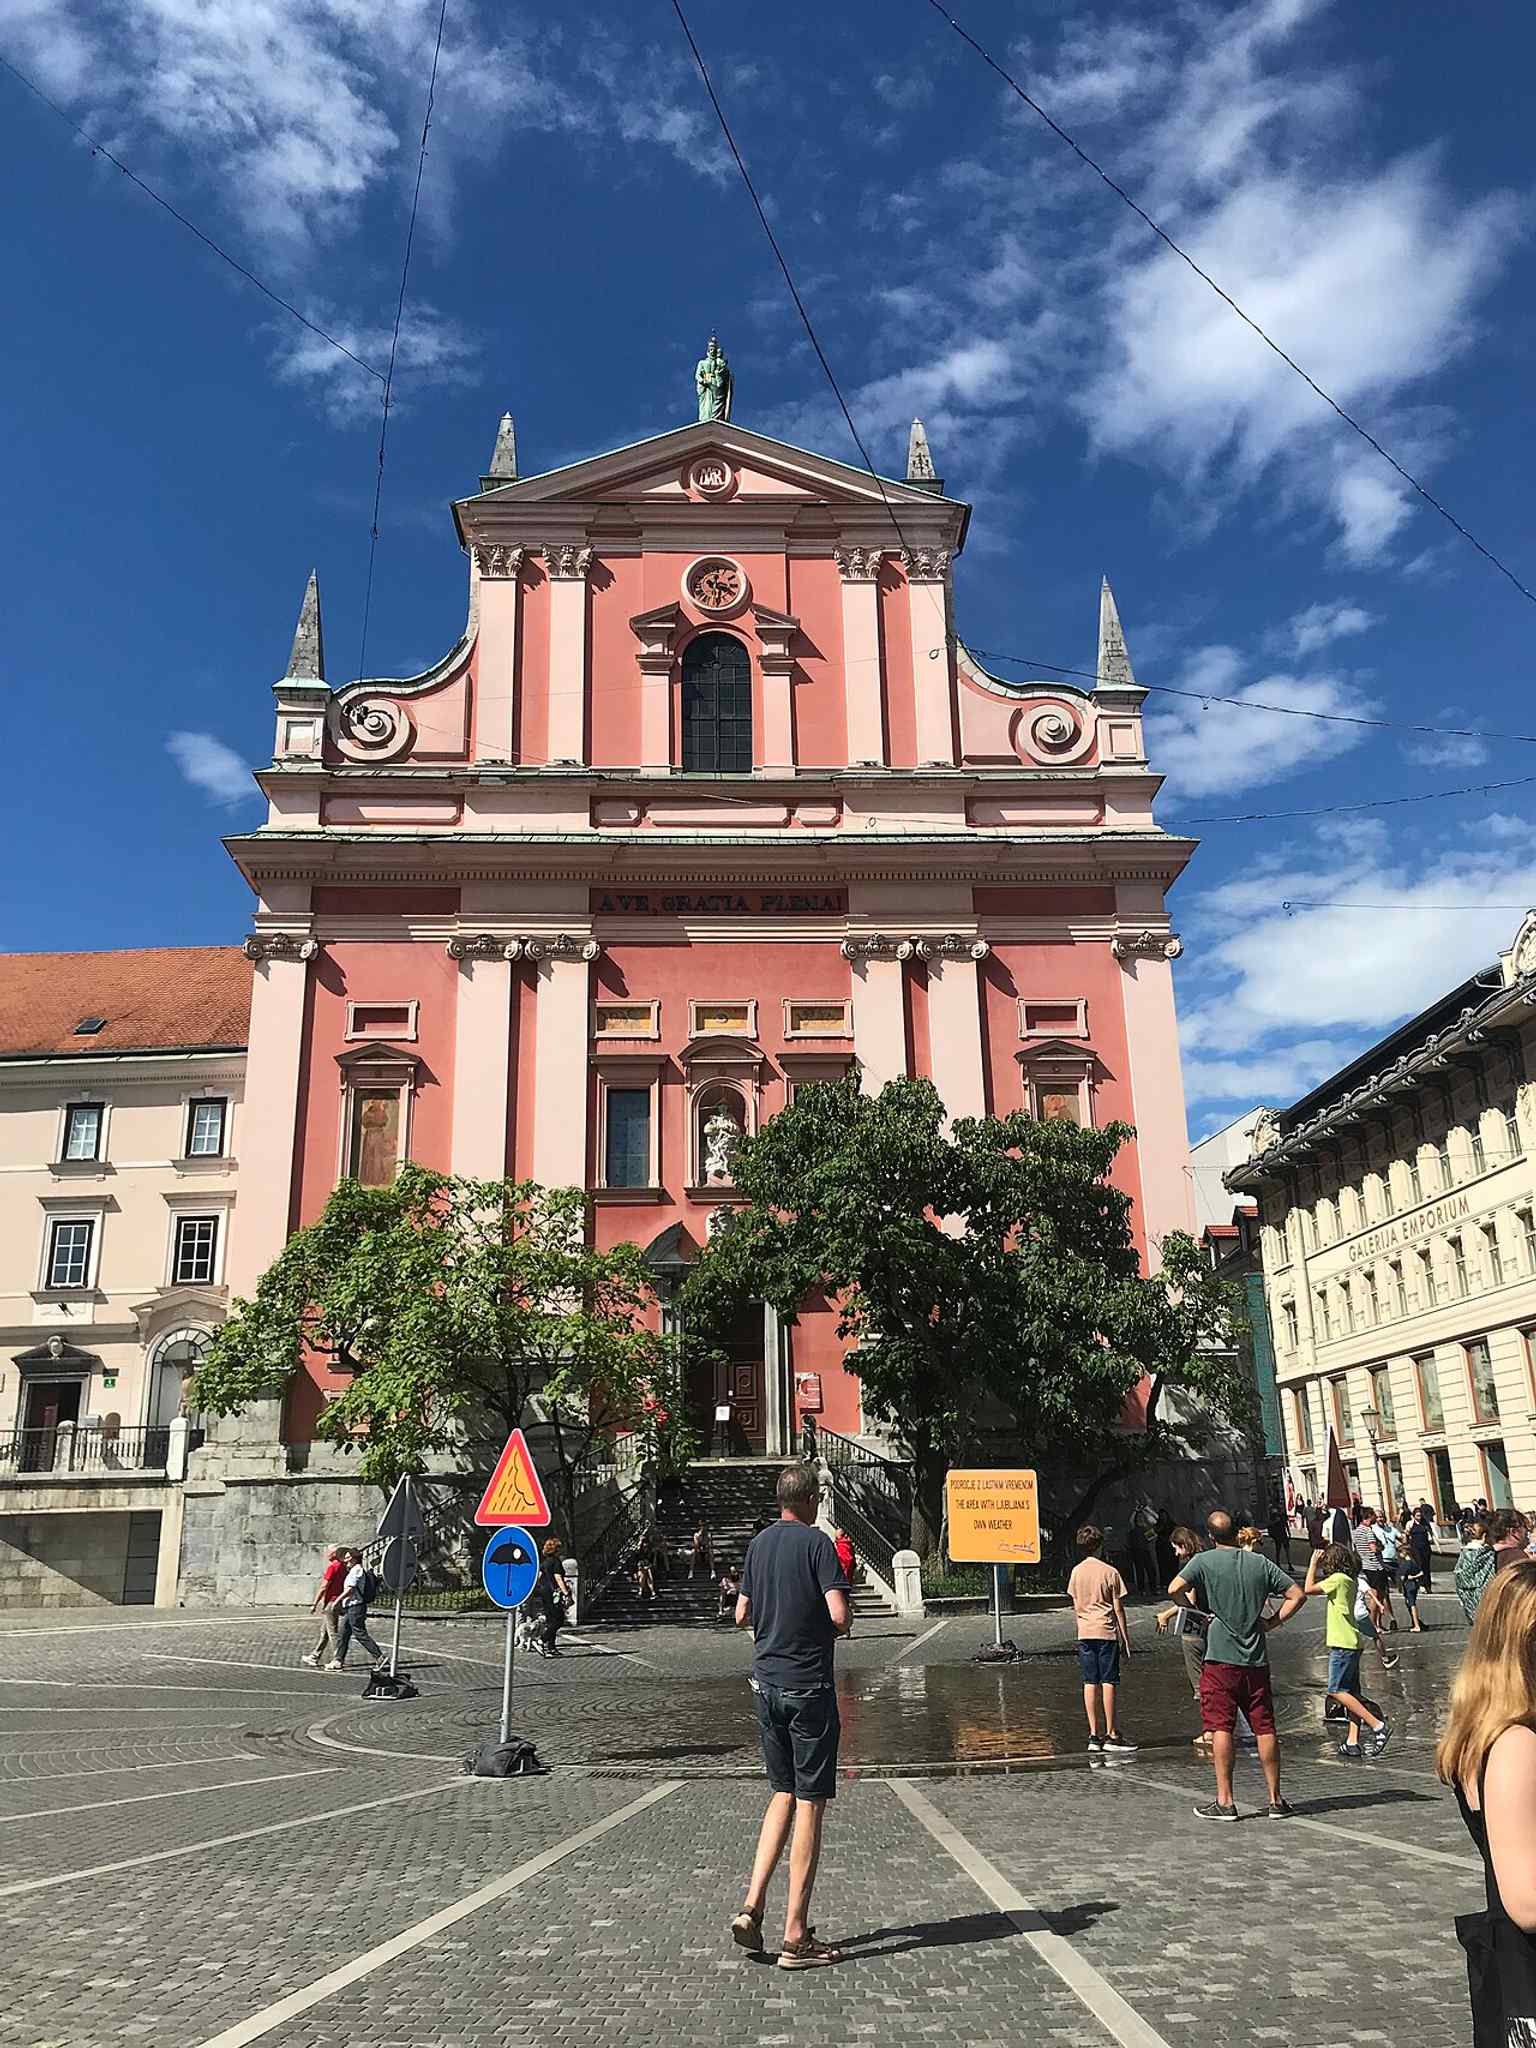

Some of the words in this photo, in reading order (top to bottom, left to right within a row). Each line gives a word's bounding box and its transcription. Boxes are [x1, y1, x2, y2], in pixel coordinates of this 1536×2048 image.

[661, 895, 752, 911] GRATIA
[1348, 1228, 1399, 1262] GALERIJA
[1402, 1194, 1470, 1240] EMPORIUM
[955, 1499, 965, 1510] THE
[966, 1499, 979, 1510] AREA
[980, 1499, 995, 1510] WITH
[973, 1519, 986, 1530] OWN
[987, 1519, 1013, 1530] WEATHER
